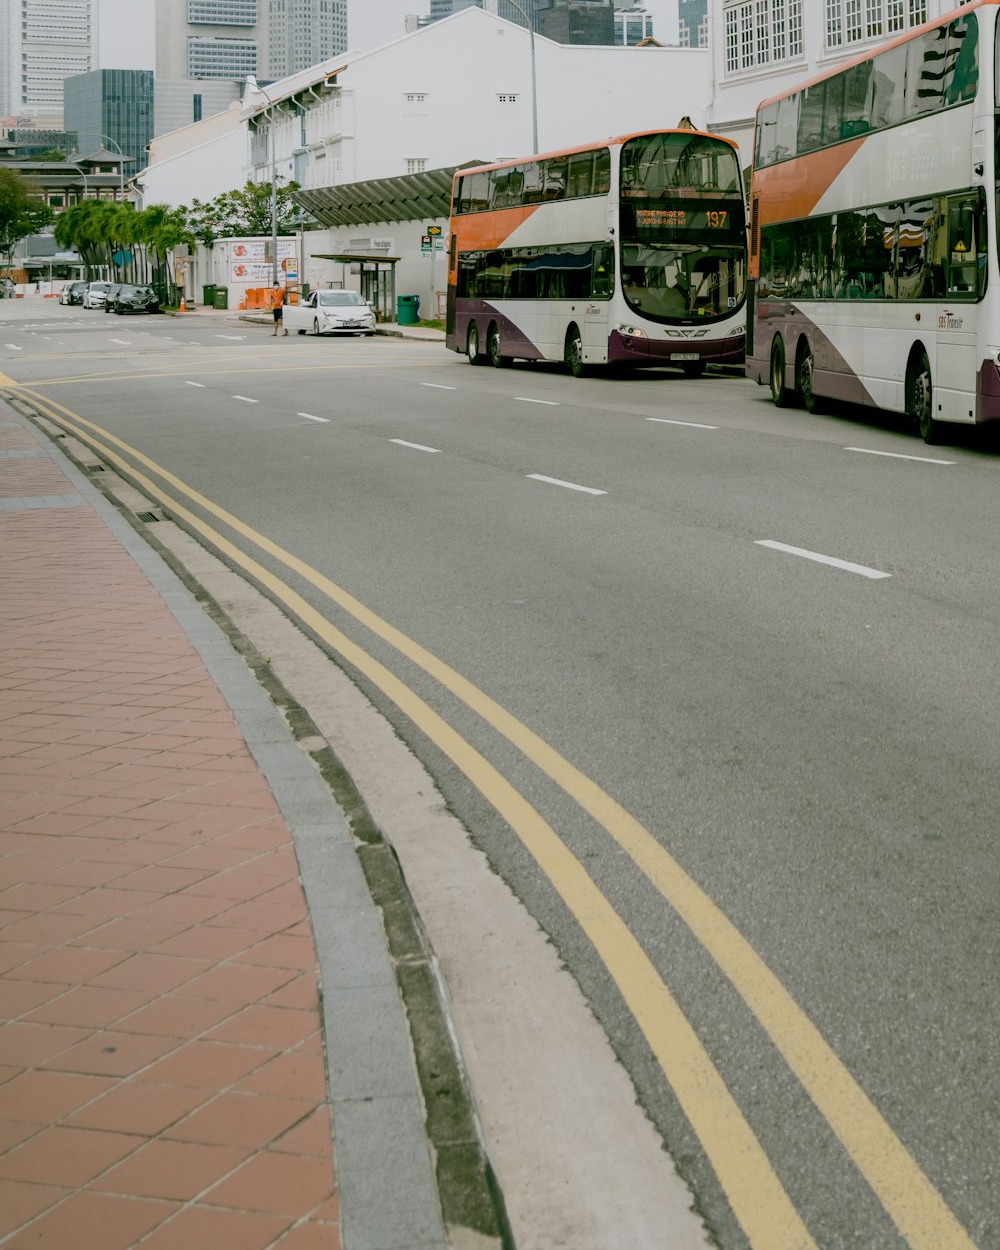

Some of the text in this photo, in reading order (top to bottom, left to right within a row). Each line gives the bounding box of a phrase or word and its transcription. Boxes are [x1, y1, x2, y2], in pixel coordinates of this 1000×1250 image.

[705, 210, 728, 227] 197
[938, 313, 963, 329] SBS Transit
